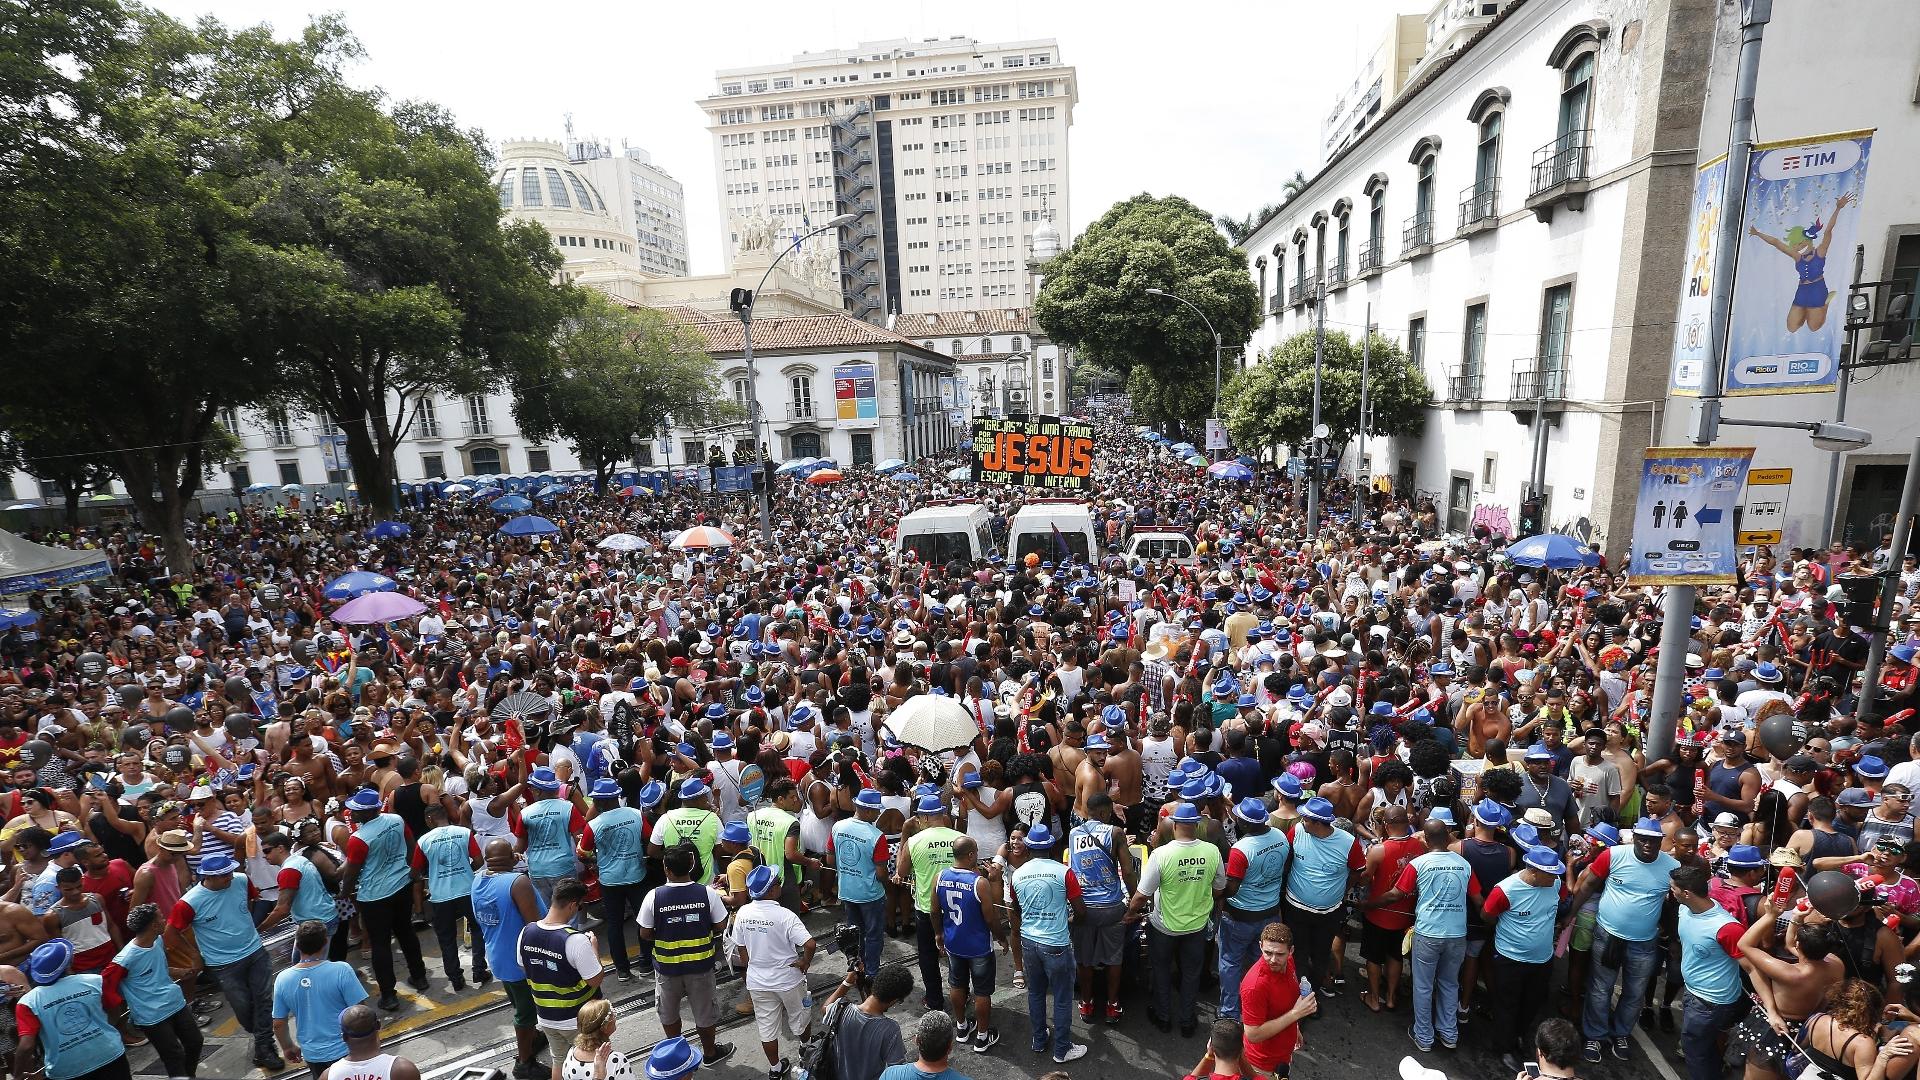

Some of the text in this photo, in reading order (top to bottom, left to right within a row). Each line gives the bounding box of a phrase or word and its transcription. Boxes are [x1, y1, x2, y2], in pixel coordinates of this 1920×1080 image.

[1803, 151, 1836, 168] TIM
[1790, 362, 1809, 370] RIO
[978, 430, 991, 438] POR
[1041, 423, 1060, 436] UMA
[1063, 425, 1094, 439] FRAUDE
[972, 443, 996, 453] BUSQUE
[983, 432, 1093, 477] JESUS
[980, 471, 1014, 484] ESCAPE
[1023, 475, 1036, 486] DO
[1044, 475, 1081, 488] INFERNO
[928, 840, 955, 849] APOIO
[1178, 857, 1206, 867] APOIO
[659, 902, 706, 913] ORDENAMENTO
[946, 890, 963, 926] 5
[523, 945, 563, 960] ORDENAMENTO
